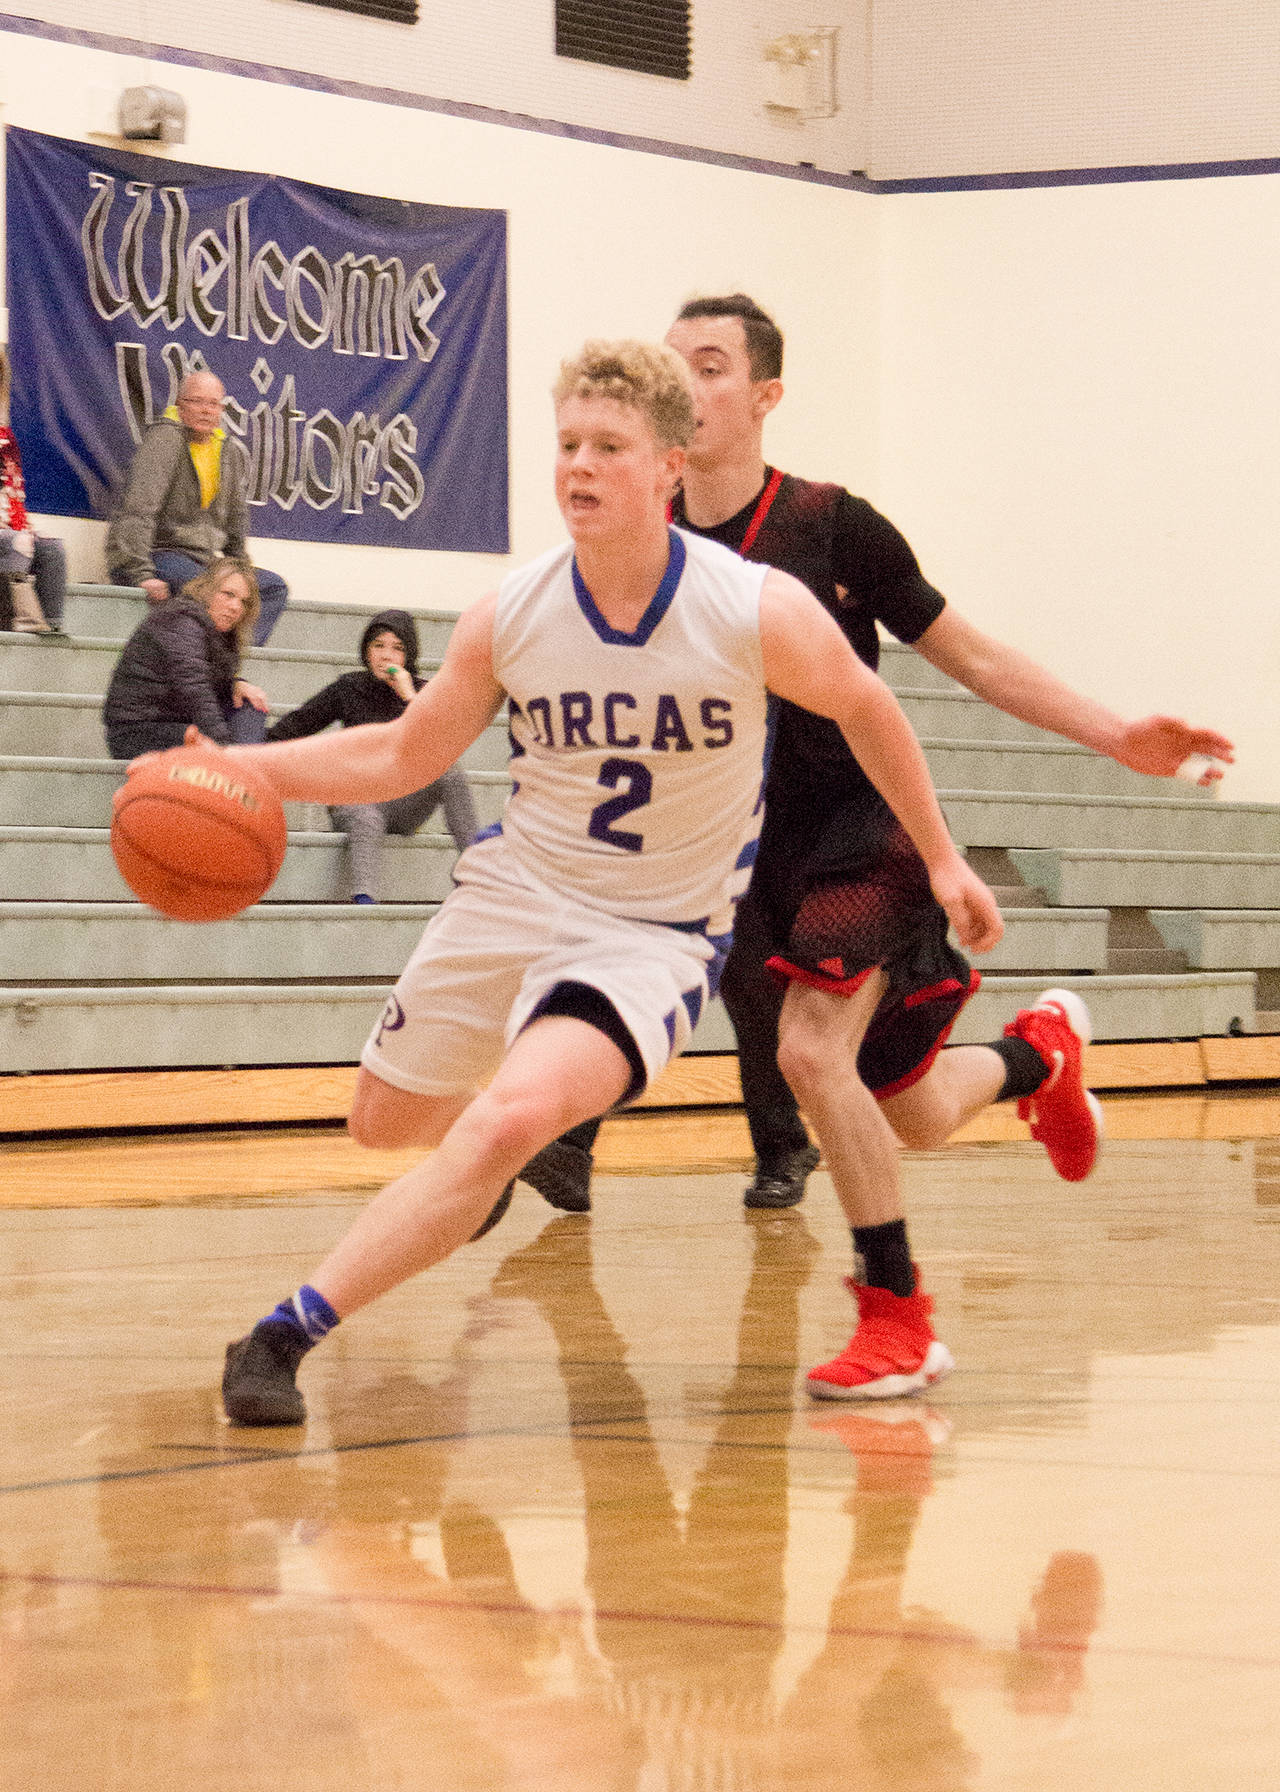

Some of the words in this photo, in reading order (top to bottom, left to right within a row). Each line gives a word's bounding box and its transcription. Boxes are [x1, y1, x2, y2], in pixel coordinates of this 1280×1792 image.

[81, 172, 446, 362] Welcome
[508, 690, 735, 756] ORCAS
[587, 757, 653, 853] 2
